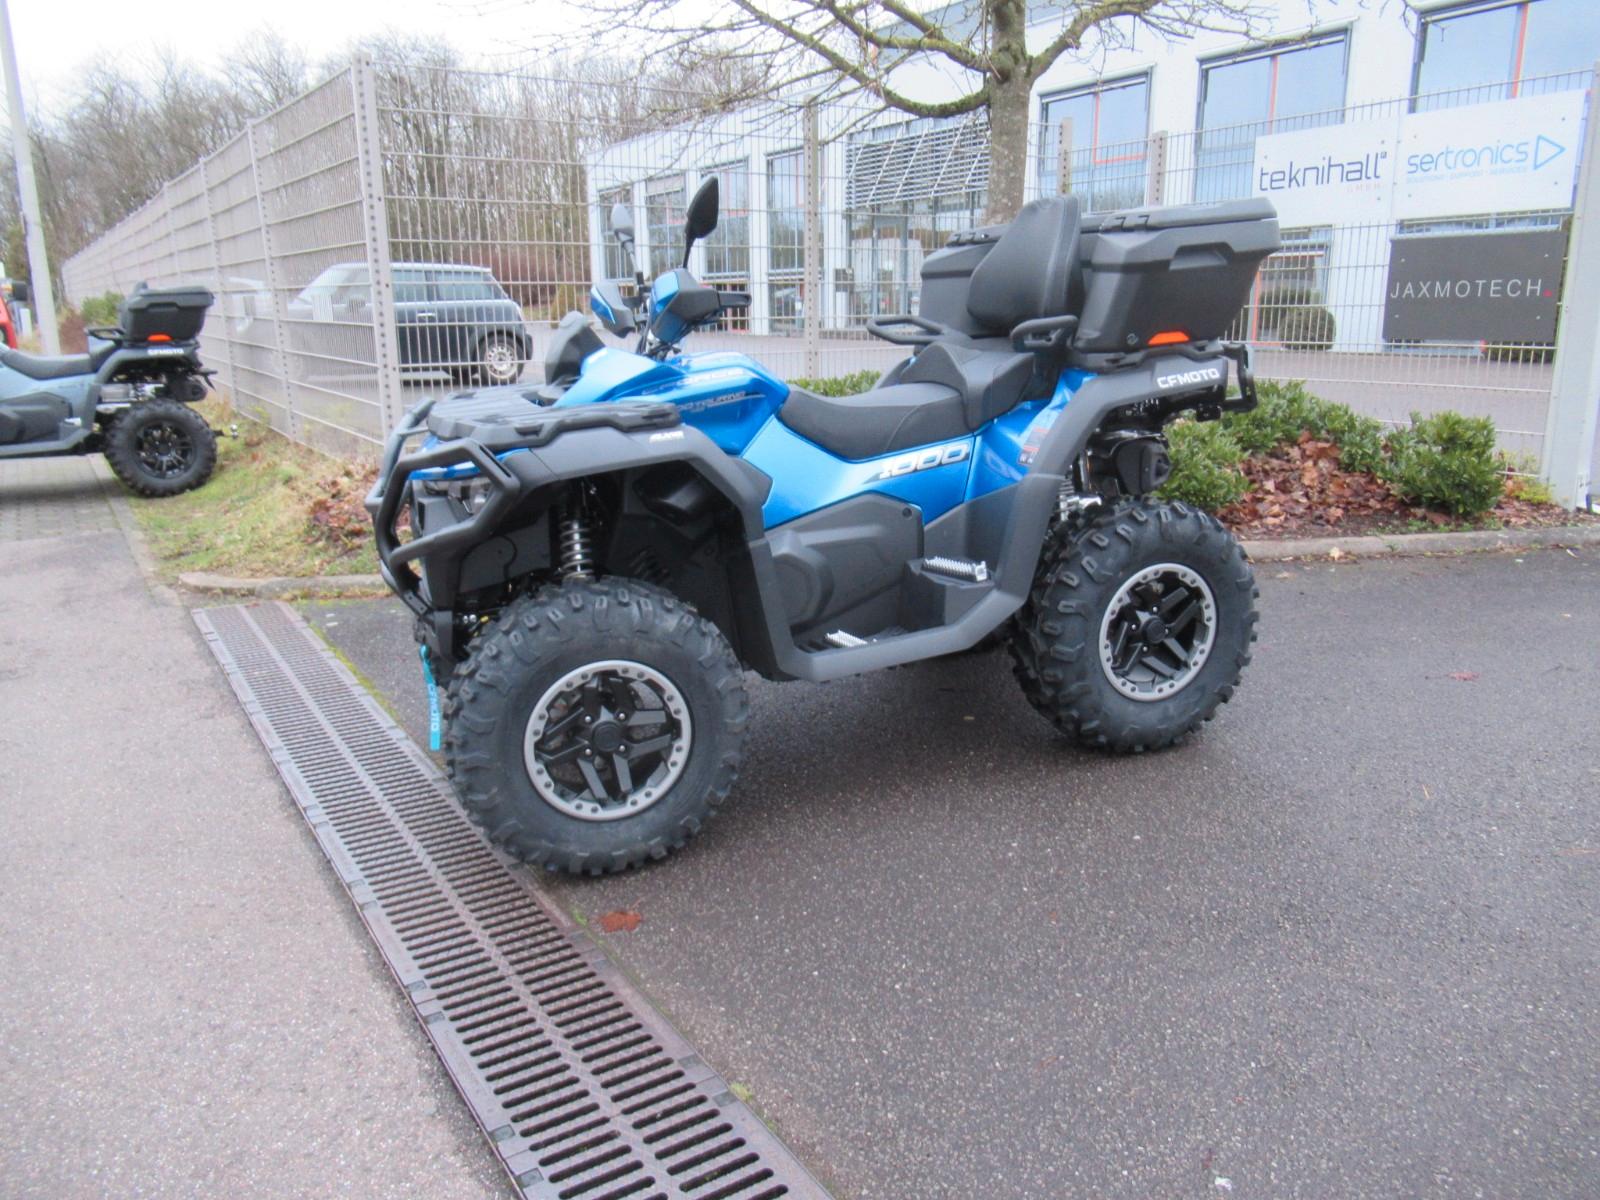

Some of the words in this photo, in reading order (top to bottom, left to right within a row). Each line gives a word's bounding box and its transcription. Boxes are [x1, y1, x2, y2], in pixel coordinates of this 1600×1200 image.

[1259, 152, 1382, 191] teknihall
[1407, 140, 1530, 174] sertronics
[1156, 367, 1220, 388] CFMOTO
[879, 442, 970, 480] 1000
